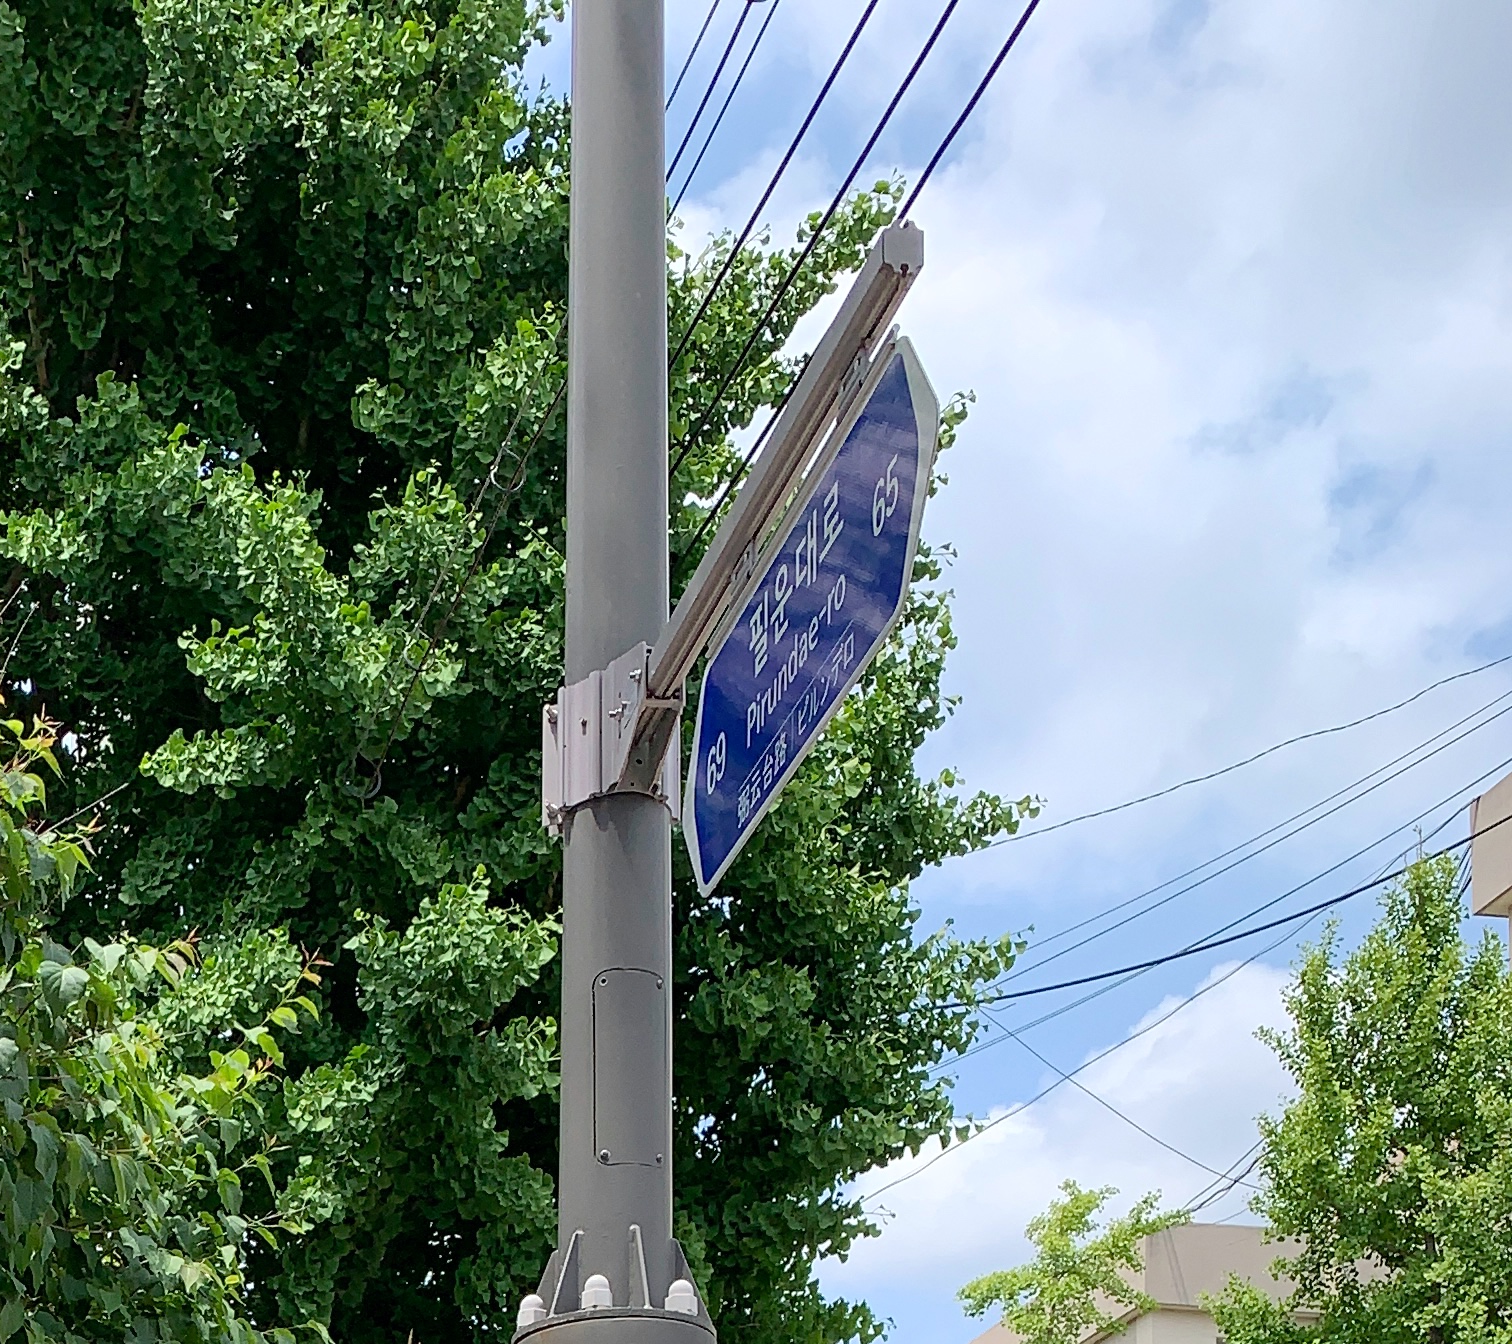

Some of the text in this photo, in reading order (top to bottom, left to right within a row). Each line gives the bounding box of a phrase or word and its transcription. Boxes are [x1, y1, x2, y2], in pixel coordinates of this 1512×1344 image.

[872, 453, 899, 537] 65
[749, 480, 845, 679] 필운대로
[746, 573, 846, 749] Pirundae-ro
[797, 631, 855, 736] ピルンデロ
[706, 731, 727, 795] 69
